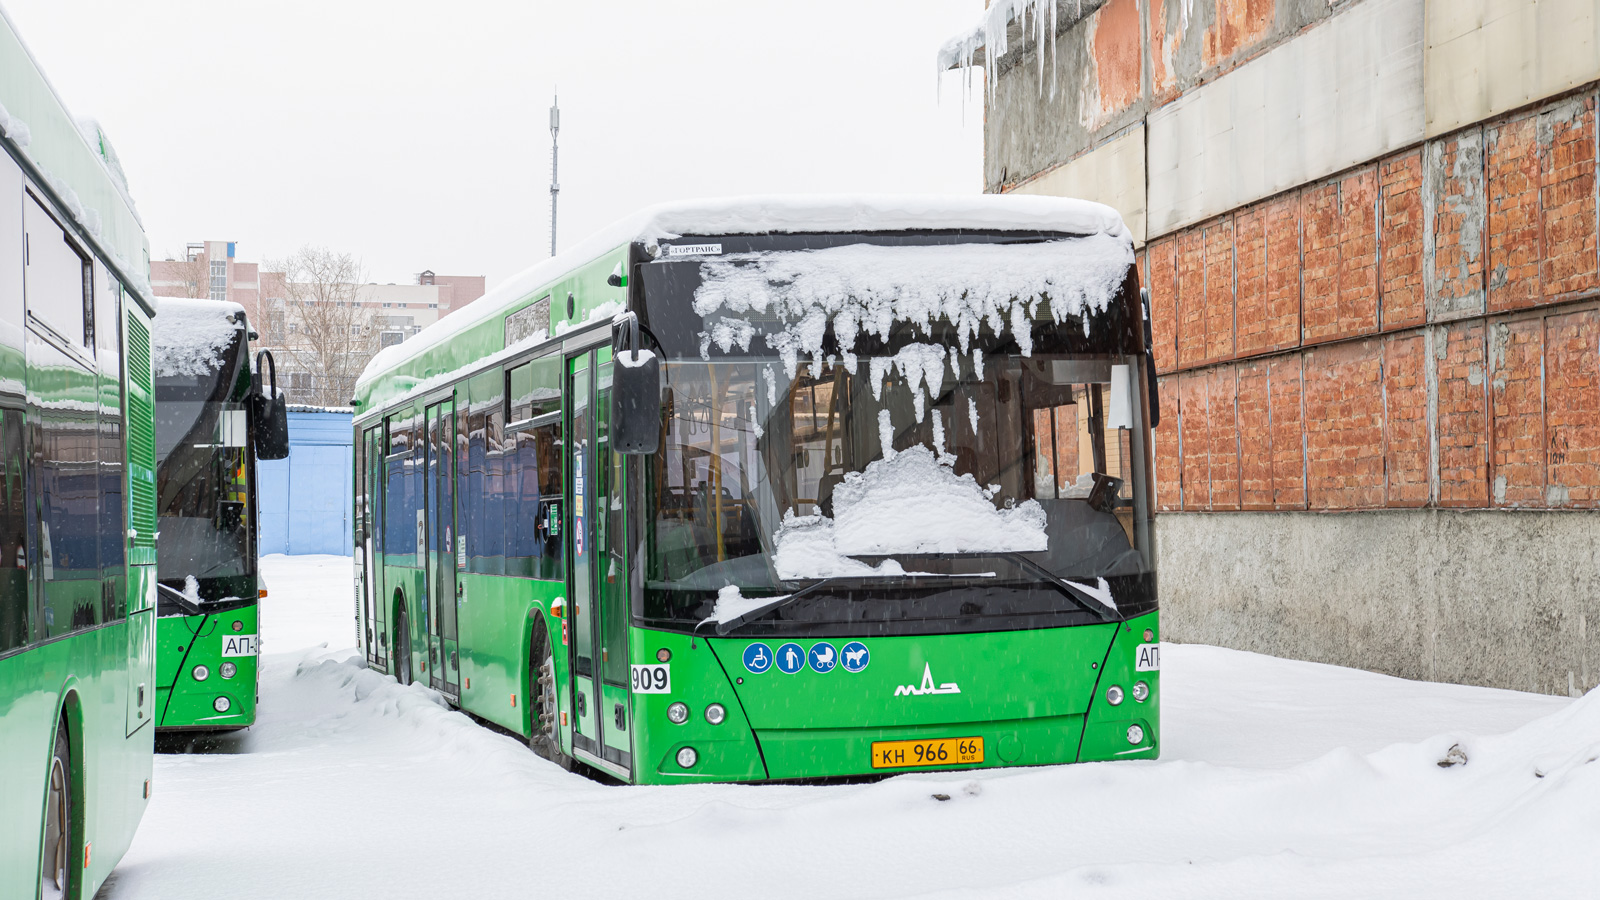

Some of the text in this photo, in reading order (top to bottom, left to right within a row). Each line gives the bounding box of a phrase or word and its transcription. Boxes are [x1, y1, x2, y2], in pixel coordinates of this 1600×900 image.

[633, 667, 668, 690] 909
[894, 661, 961, 696] МАЗ
[883, 740, 977, 764] КН 966 66
